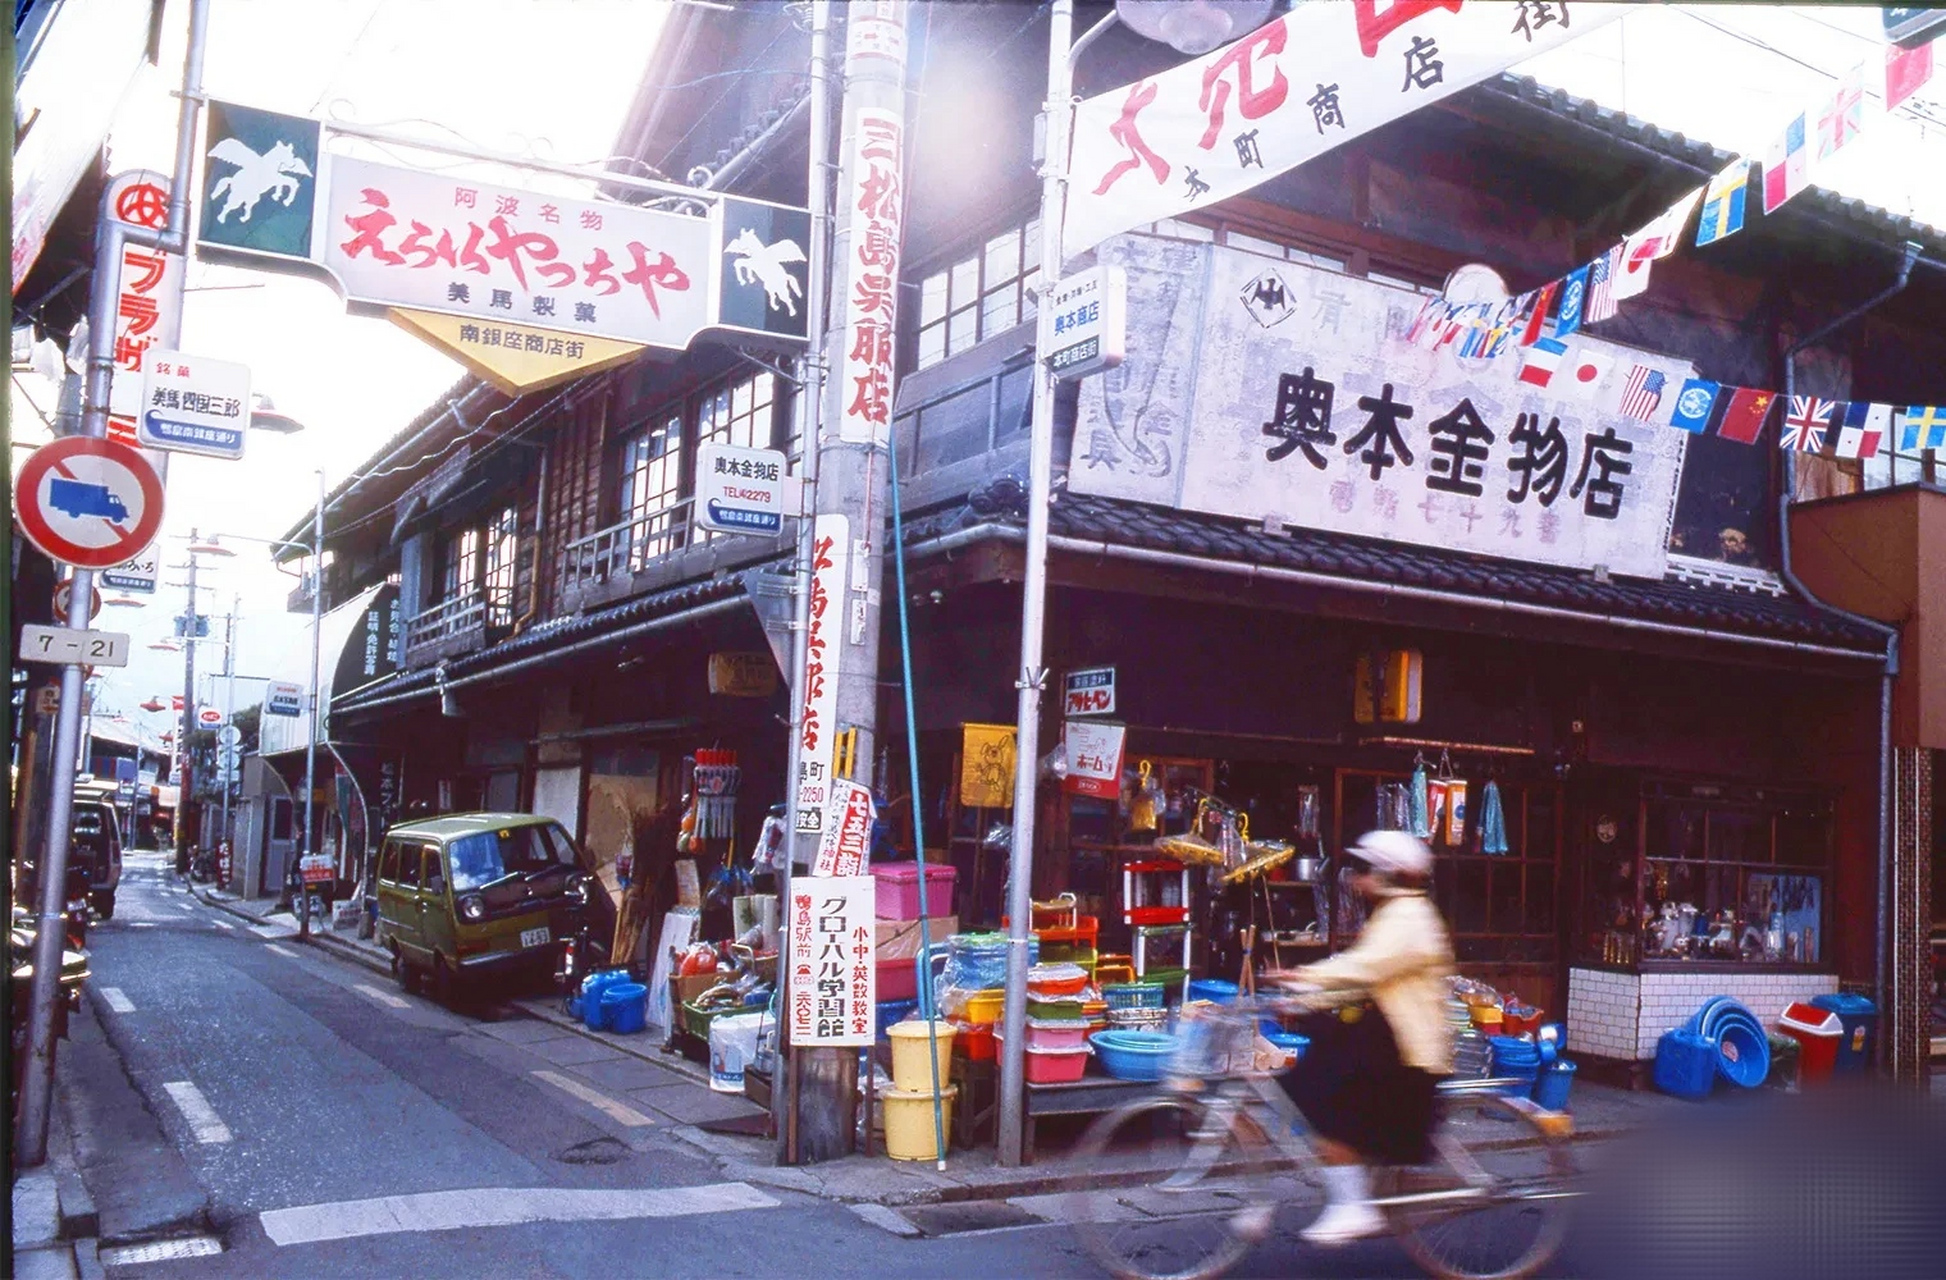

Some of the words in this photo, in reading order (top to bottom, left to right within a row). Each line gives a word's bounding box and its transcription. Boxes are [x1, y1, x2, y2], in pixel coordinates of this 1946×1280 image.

[454, 187, 603, 231] 阿波名物
[448, 281, 597, 323] 美馬製菓
[460, 324, 584, 359] 南銀座商店街
[1262, 366, 1635, 520] 奥本金物店
[714, 456, 779, 482] 奥本金物店
